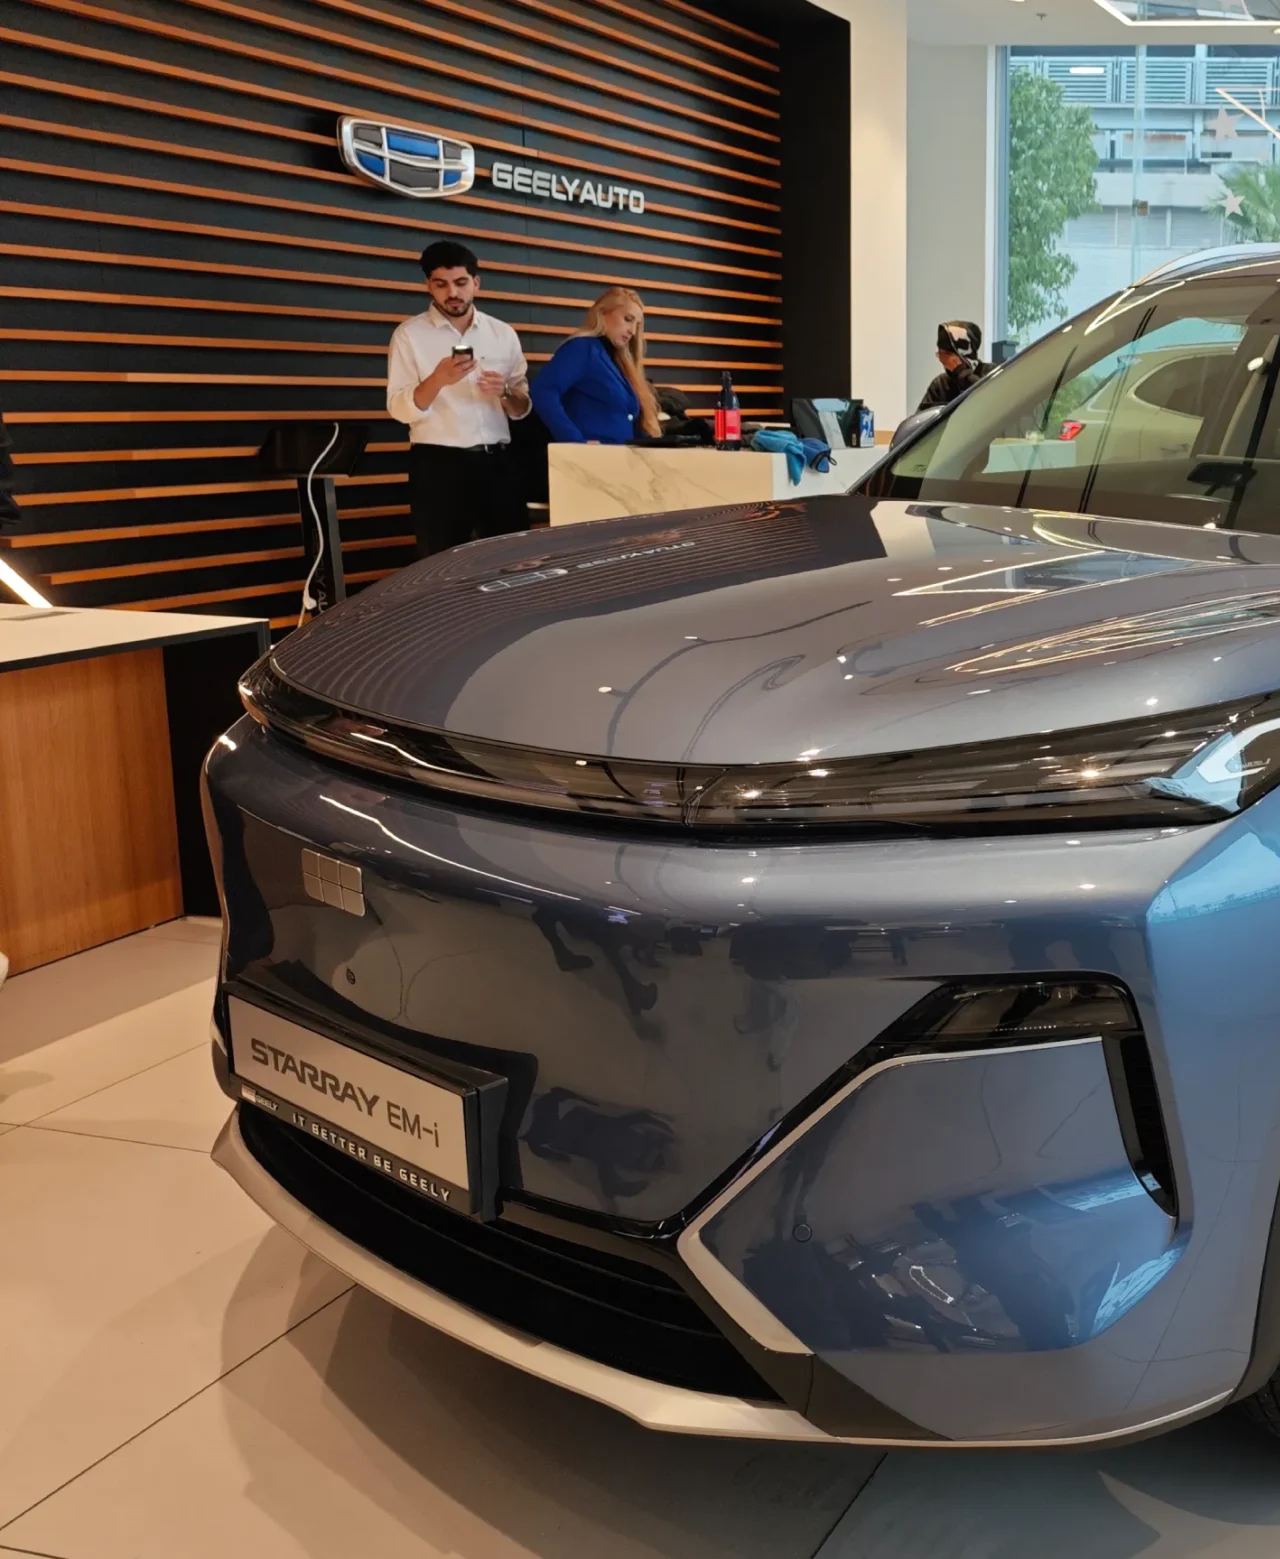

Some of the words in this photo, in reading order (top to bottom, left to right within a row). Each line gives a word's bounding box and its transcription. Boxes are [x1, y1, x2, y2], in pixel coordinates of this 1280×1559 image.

[492, 163, 645, 214] GEELYAUTO
[251, 1038, 380, 1116] STARRAY
[387, 1102, 440, 1147] EM-i
[292, 1113, 306, 1128] IT
[312, 1123, 367, 1161] BETTER
[374, 1155, 392, 1173] BE
[400, 1168, 450, 1202] GEELY
